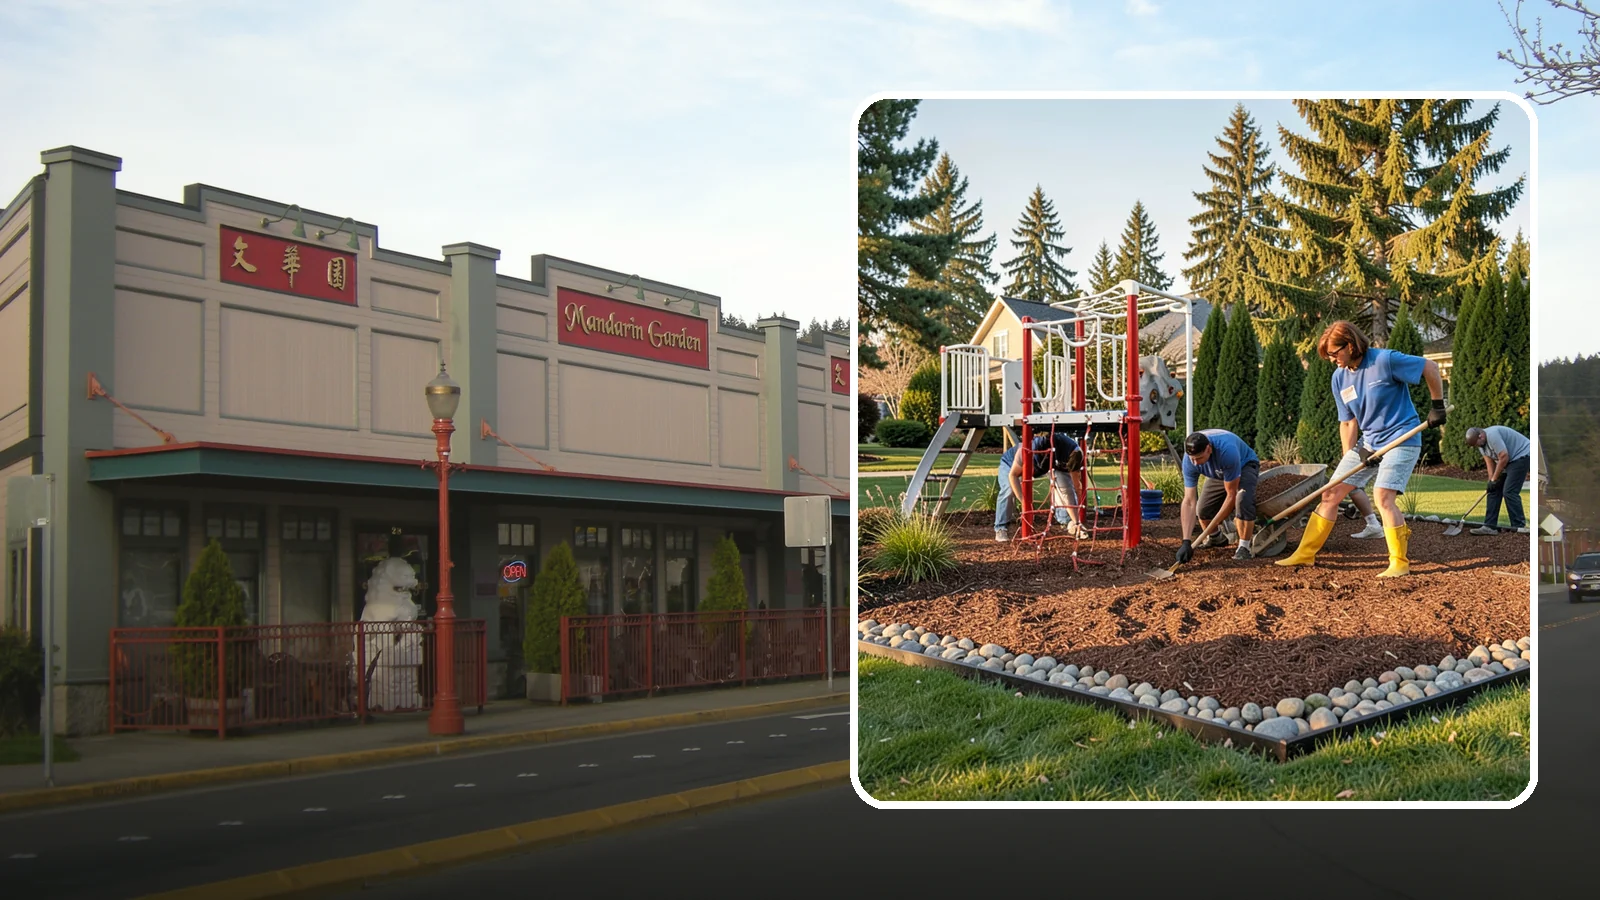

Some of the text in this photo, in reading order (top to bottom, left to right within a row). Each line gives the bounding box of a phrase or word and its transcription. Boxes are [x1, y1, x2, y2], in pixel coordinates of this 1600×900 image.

[231, 236, 346, 291] 文華園
[564, 302, 701, 352] Mandarin Garden
[503, 565, 527, 578] OPEN
